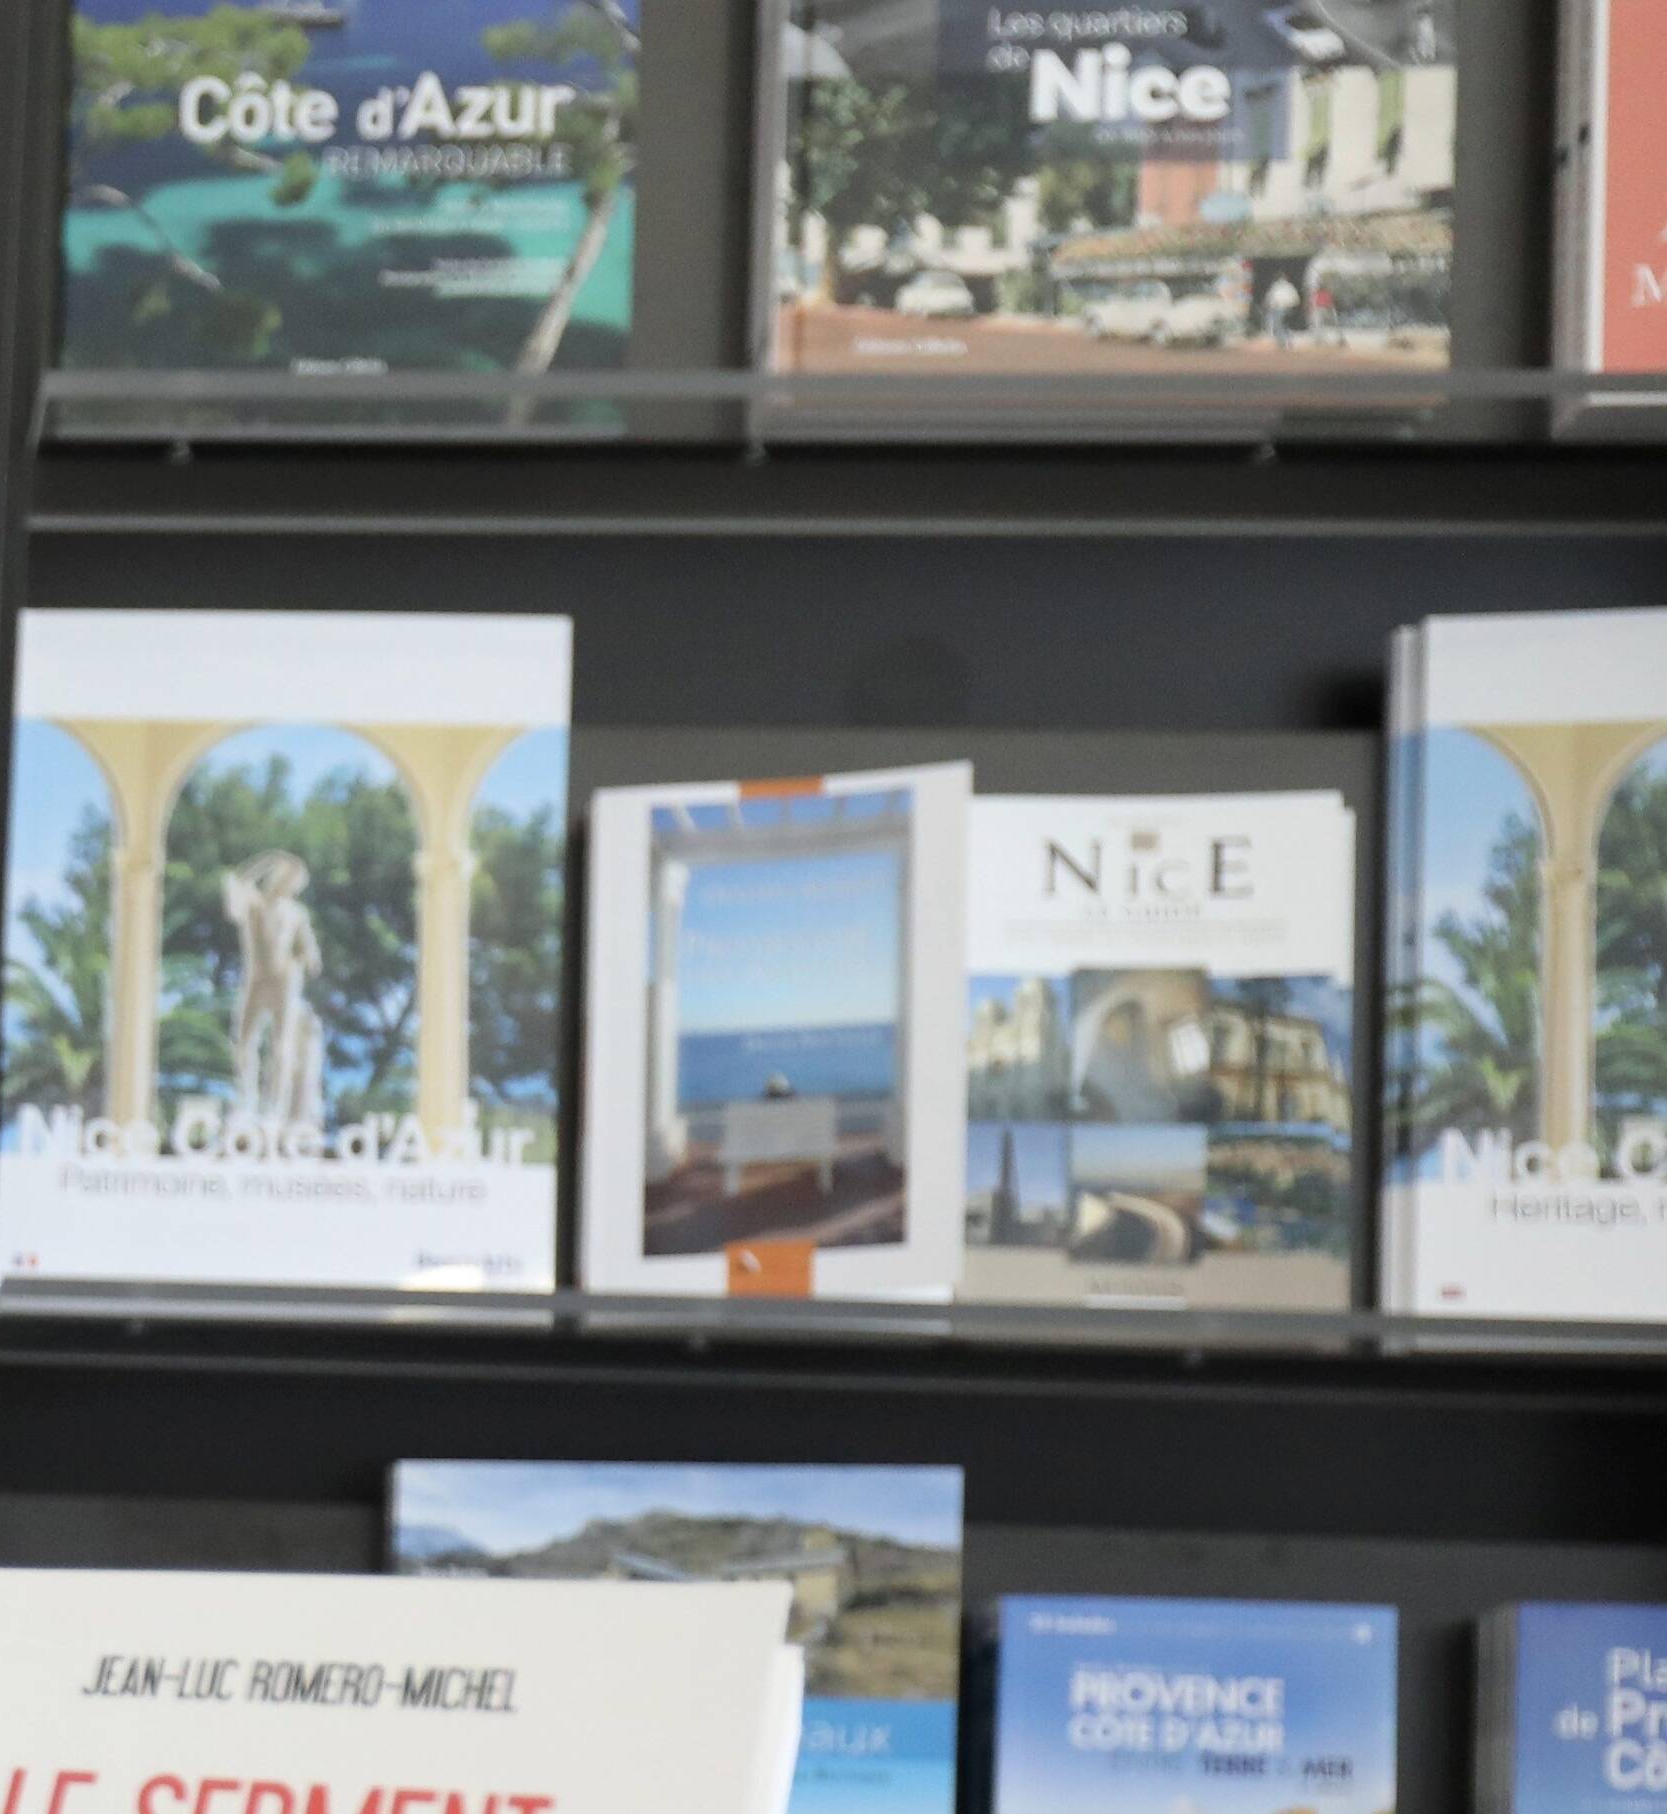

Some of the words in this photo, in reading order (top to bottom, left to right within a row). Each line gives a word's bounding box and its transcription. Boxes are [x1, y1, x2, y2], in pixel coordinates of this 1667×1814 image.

[988, 6, 1043, 37] Les
[177, 71, 339, 144] Côte
[356, 70, 576, 142] d'Azur
[1029, 43, 1230, 122] Nice
[324, 143, 569, 179] REMARQUABLE
[13, 1100, 160, 1160] Nice
[173, 1097, 325, 1163] Côte
[336, 1102, 536, 1170] d'Azur
[1441, 1126, 1600, 1185] Nice
[60, 1167, 229, 1202] Patrimoine,
[386, 1170, 487, 1203] nature
[81, 1654, 241, 1703] JEAN-LUC
[248, 1661, 521, 1714] ROMERO-MICHEL
[1070, 1668, 1285, 1720] PROVENCE
[1166, 1713, 1284, 1754] D'AZUR
[1199, 1752, 1269, 1779] TERRE
[1301, 1756, 1355, 1781] MER
